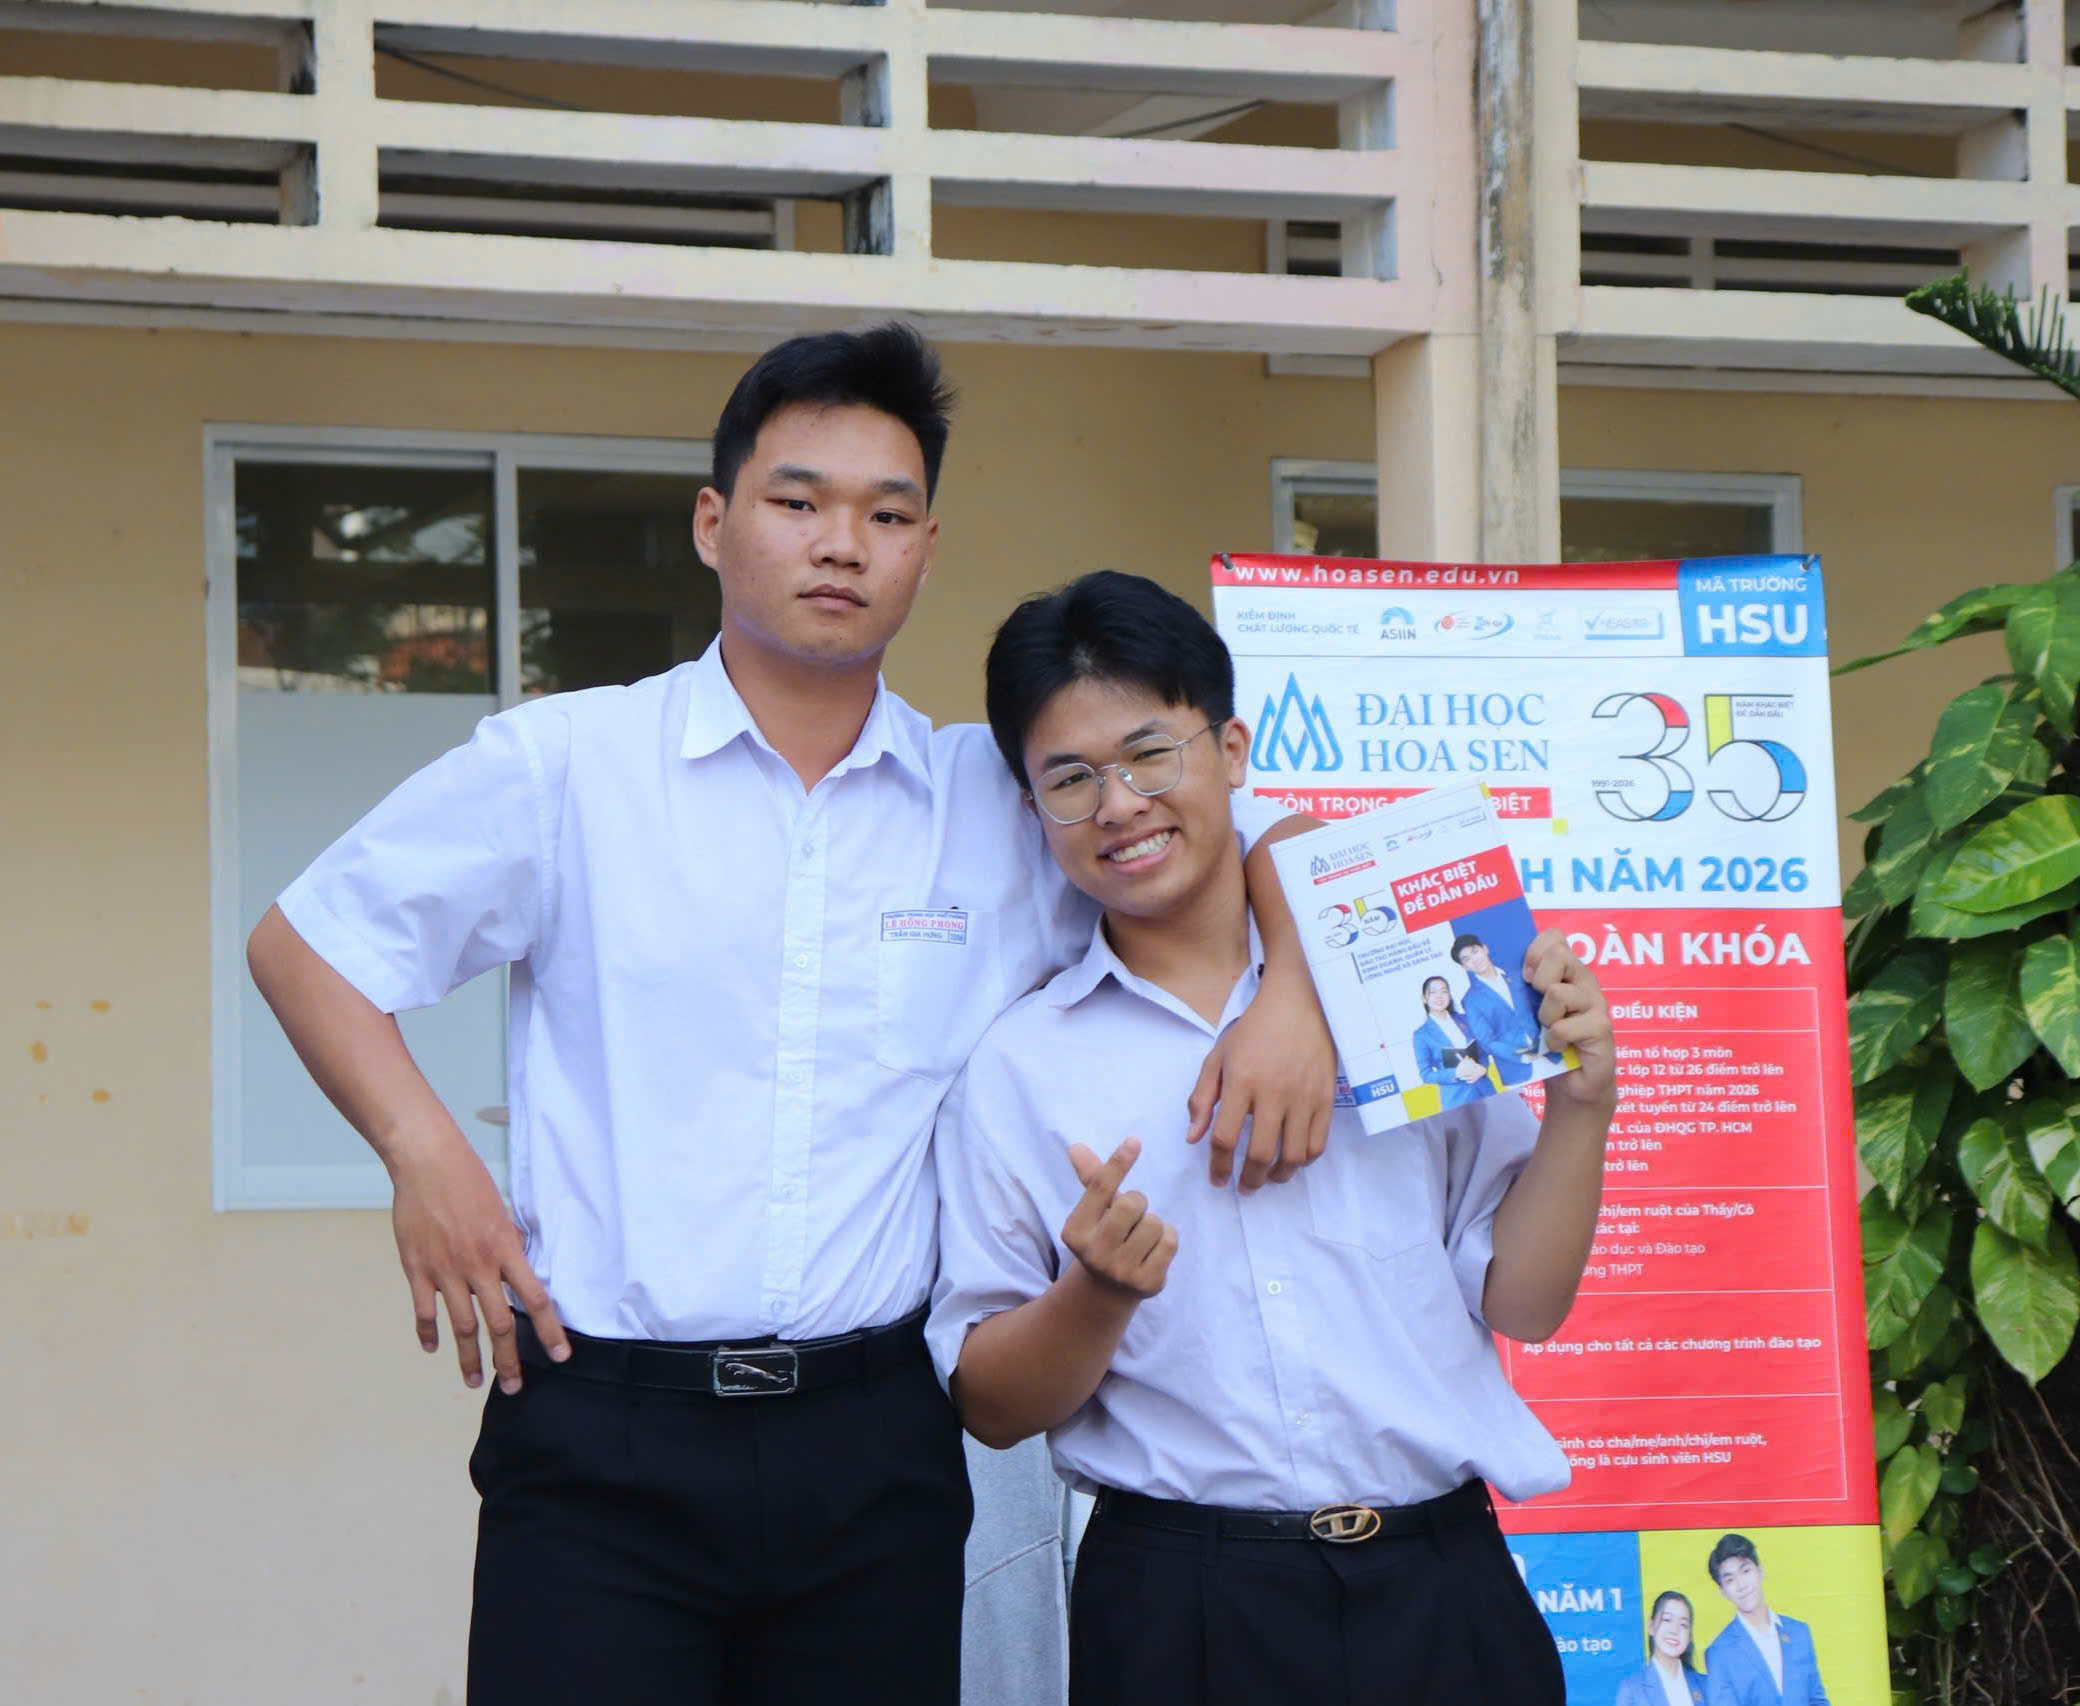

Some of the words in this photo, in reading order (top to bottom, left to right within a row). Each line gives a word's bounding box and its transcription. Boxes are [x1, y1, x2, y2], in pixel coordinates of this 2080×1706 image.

[1235, 564, 1520, 585] www.hoasen.edu.vn
[1696, 576, 1726, 592] MÃ
[1728, 575, 1808, 592] TRƯỜNG
[1697, 602, 1808, 645] HSU
[1380, 628, 1416, 640] ASIIN
[1356, 693, 1433, 730] ĐẠI
[1445, 693, 1546, 731] HỌC
[1360, 739, 1457, 772] HOA
[1468, 739, 1551, 772] SEN
[1319, 796, 1387, 815] TRỌNG
[1572, 848, 1684, 892] NĂM
[1699, 856, 1809, 892] 2026
[1397, 872, 1442, 897] KHÁC
[1443, 860, 1477, 883] BIỆT
[931, 920, 964, 930] PHONG
[1566, 923, 1664, 965] OÀN
[1682, 924, 1811, 966] KHÓA
[1612, 1001, 1654, 1019] ĐIỀU
[1658, 1003, 1698, 1022] KIỆN
[1616, 1046, 1642, 1058] iểm
[1663, 1047, 1689, 1060] hợp
[1692, 1048, 1700, 1058] 3
[1703, 1046, 1733, 1058] môn
[1629, 1064, 1650, 1078] lớp
[1654, 1064, 1666, 1076] 12
[1687, 1064, 1704, 1076] 26
[1706, 1062, 1739, 1076] điểm
[1762, 1063, 1784, 1076] lên
[1372, 1083, 1395, 1098] HSU
[1616, 1084, 1656, 1100] ghiệp
[1658, 1084, 1694, 1096] THPT
[1696, 1084, 1726, 1096] năm
[1729, 1084, 1760, 1096] 2026
[1639, 1100, 1678, 1116] tuyển
[1698, 1102, 1714, 1112] 24
[1718, 1100, 1751, 1112] điểm
[1753, 1100, 1772, 1112] trở
[1775, 1100, 1797, 1112] lên
[1628, 1120, 1652, 1134] của
[1654, 1122, 1696, 1136] ĐHQG
[1618, 1138, 1638, 1151] trở
[1642, 1138, 1662, 1151] lên
[1627, 1160, 1649, 1172] lên
[1644, 1204, 1673, 1218] ruột
[1676, 1203, 1700, 1216] của
[1610, 1243, 1635, 1256] dục
[1638, 1242, 1654, 1254] và
[1655, 1242, 1682, 1254] Đào
[1685, 1244, 1706, 1256] tạo
[1609, 1264, 1644, 1276] THPT
[1546, 1340, 1584, 1354] dụng
[1587, 1340, 1612, 1352] cho
[1616, 1338, 1634, 1351] tất
[1638, 1338, 1654, 1351] cả
[1656, 1338, 1680, 1351] các
[1682, 1338, 1732, 1352] chương
[1734, 1336, 1766, 1350] trình
[1768, 1336, 1794, 1349] đào
[1797, 1336, 1822, 1350] tạo
[1588, 1436, 1604, 1448] có
[1600, 1453, 1610, 1466] là
[1614, 1454, 1639, 1469] cựu
[1641, 1452, 1670, 1465] sinh
[1672, 1452, 1701, 1464] viên
[1703, 1450, 1732, 1464] HSU
[1537, 1583, 1604, 1614] NĂM
[1610, 1588, 1622, 1612] 1
[1556, 1636, 1578, 1654] ào
[1583, 1637, 1612, 1656] tạo
